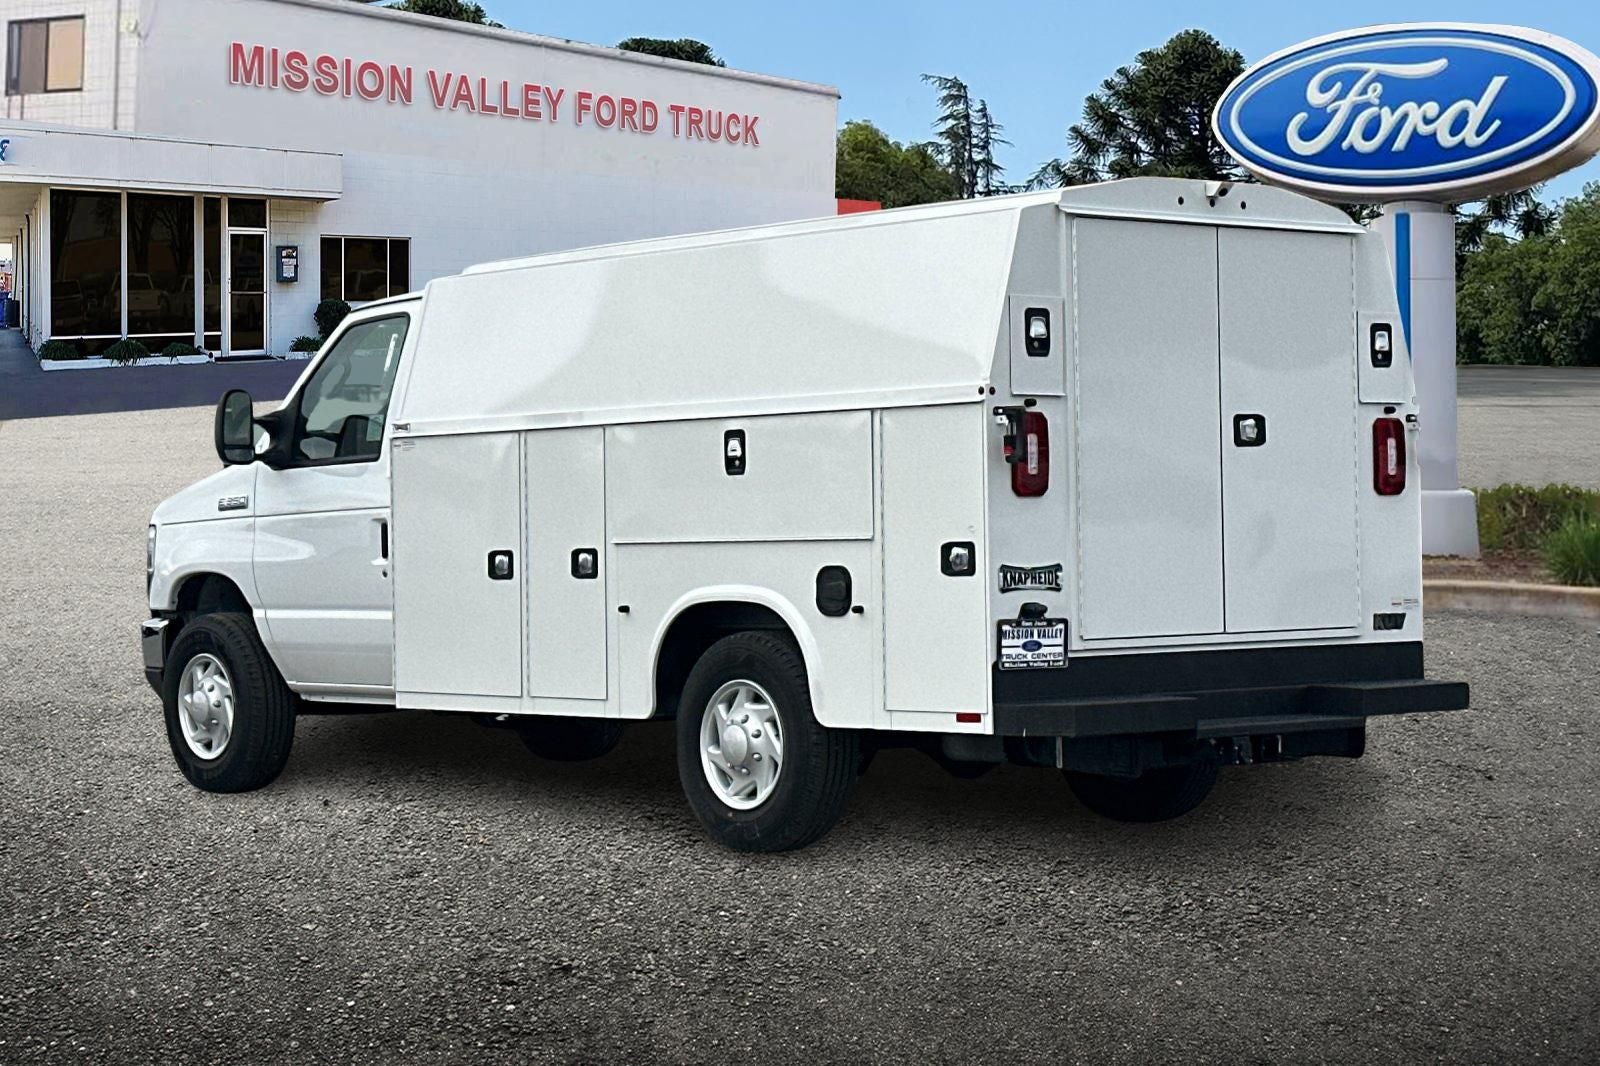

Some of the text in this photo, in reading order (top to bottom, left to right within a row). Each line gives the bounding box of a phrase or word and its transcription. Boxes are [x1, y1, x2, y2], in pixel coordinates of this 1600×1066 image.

[231, 41, 761, 146] MISSION VALLEY FORD TRUCK
[1286, 57, 1509, 156] Ford
[1002, 568, 1061, 588] KNAPHEIDE
[1002, 628, 1063, 640] MISSION VALLEY
[1030, 652, 1063, 660] CENTER
